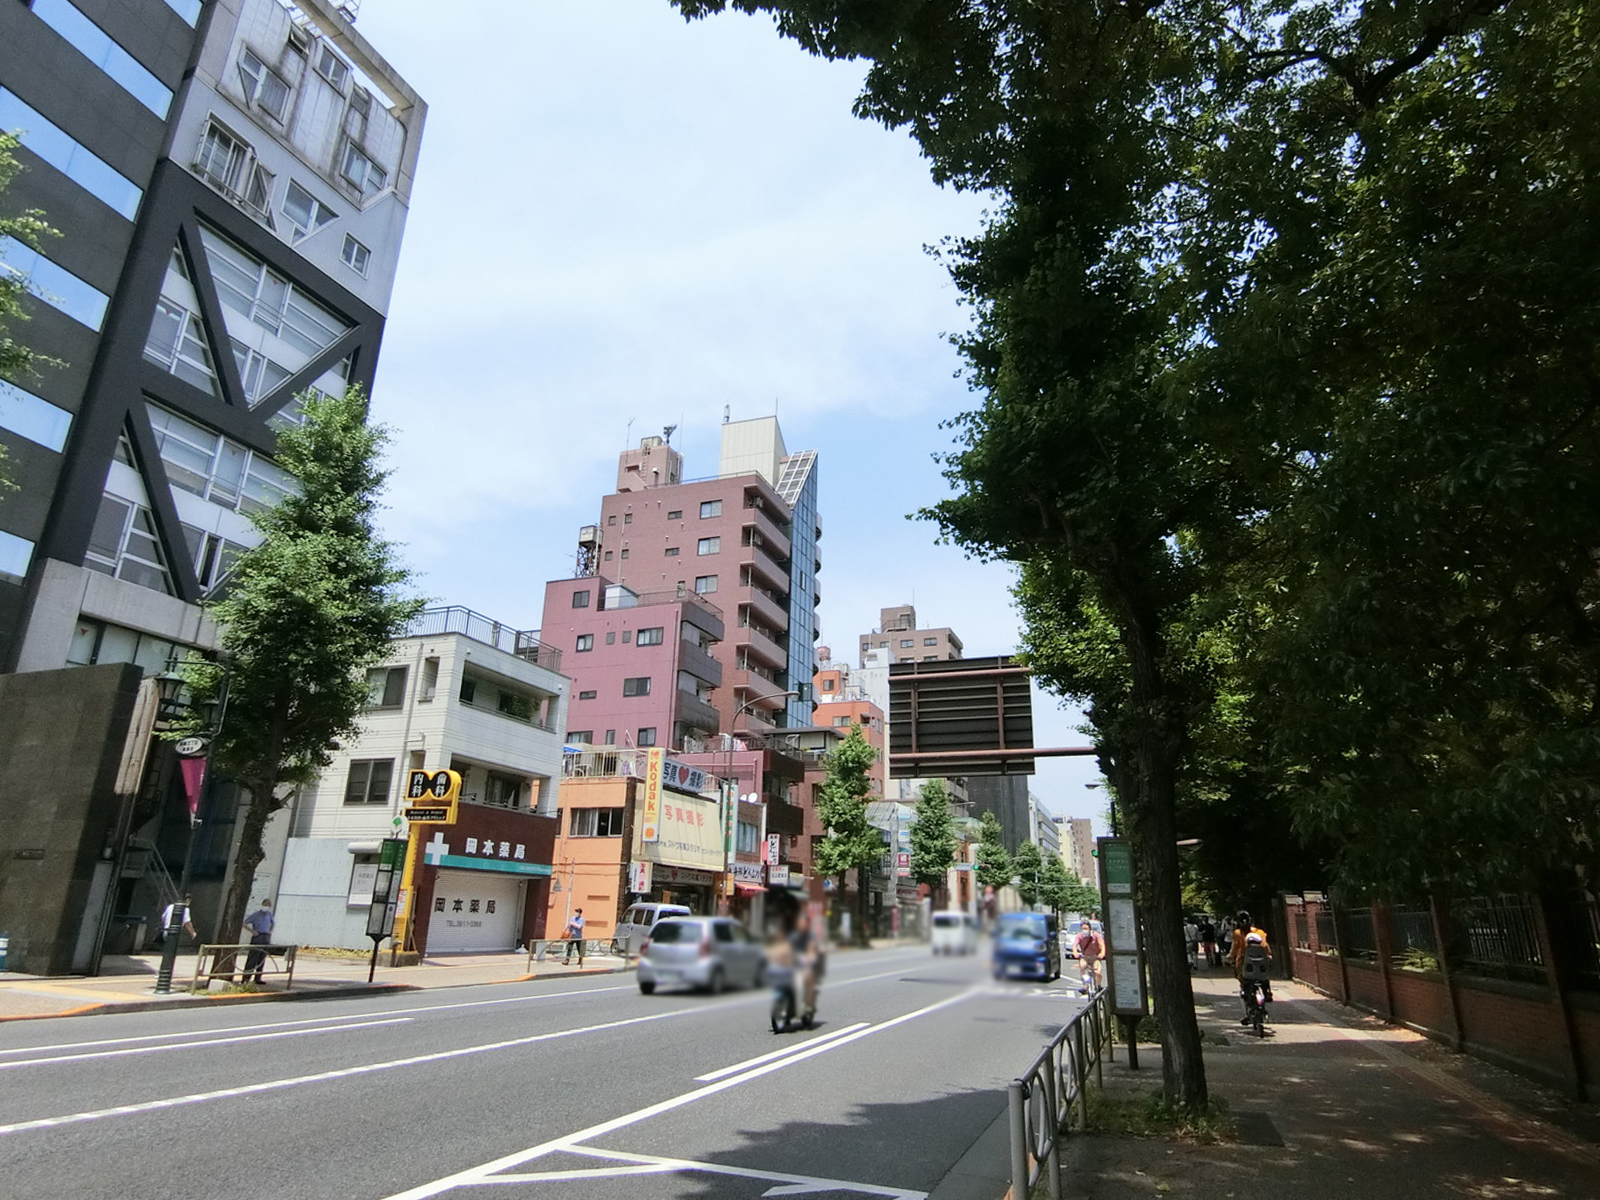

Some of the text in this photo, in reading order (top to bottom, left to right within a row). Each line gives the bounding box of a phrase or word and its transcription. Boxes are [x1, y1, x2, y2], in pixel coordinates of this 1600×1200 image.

[663, 762, 678, 783] 写真
[412, 773, 424, 797] 内科
[648, 762, 658, 811] Kodak
[465, 837, 526, 860] 岡本薬局
[434, 897, 496, 914] 岡本薬局
